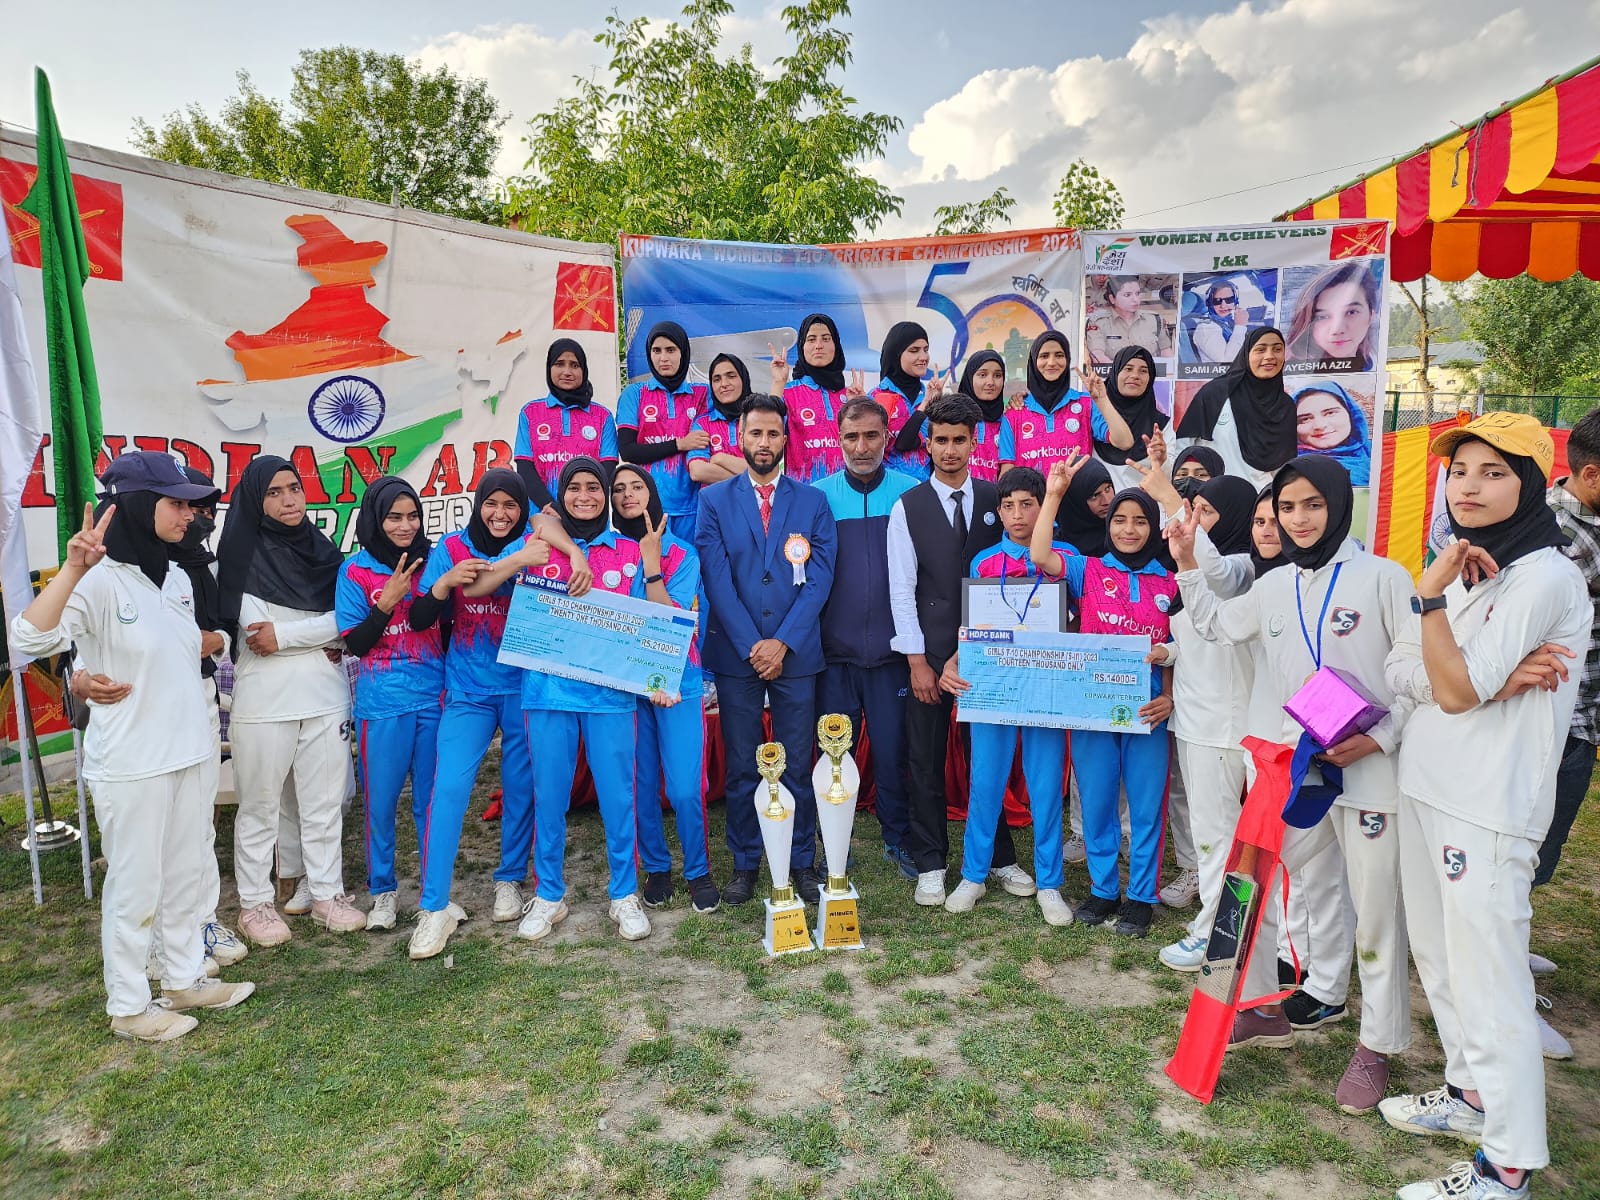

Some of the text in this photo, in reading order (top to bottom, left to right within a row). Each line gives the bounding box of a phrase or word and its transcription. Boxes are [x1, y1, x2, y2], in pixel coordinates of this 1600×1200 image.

[1138, 226, 1328, 247] WOMEN ACHIEVERS
[623, 237, 702, 261] KUPWARA
[713, 246, 783, 264] WOMENS
[831, 247, 903, 265] CRICKET
[912, 236, 1030, 262] CHAMPIONSHIP
[1212, 254, 1249, 270] J&K
[1184, 366, 1209, 374] SAMI
[1284, 360, 1352, 372] AYESHA AZIZ
[1021, 444, 1078, 460] workbudd
[525, 574, 568, 592] HDFC BANK
[538, 593, 557, 606] GIRLS
[570, 600, 615, 619] CHAMPIONSHIP
[550, 607, 575, 620] TWENTY
[576, 613, 588, 623] ONE
[590, 616, 622, 632] THOUSAND
[621, 623, 639, 635] ONLY
[968, 630, 1011, 640] HDFC BANK
[987, 648, 1005, 657] GIRLS
[1019, 649, 1065, 660] CHAMPIONSHIP
[1083, 652, 1098, 662] 2023
[998, 657, 1031, 667] FOURTEEN
[1031, 659, 1067, 670] THOUSAND
[1067, 662, 1085, 671] ONLY
